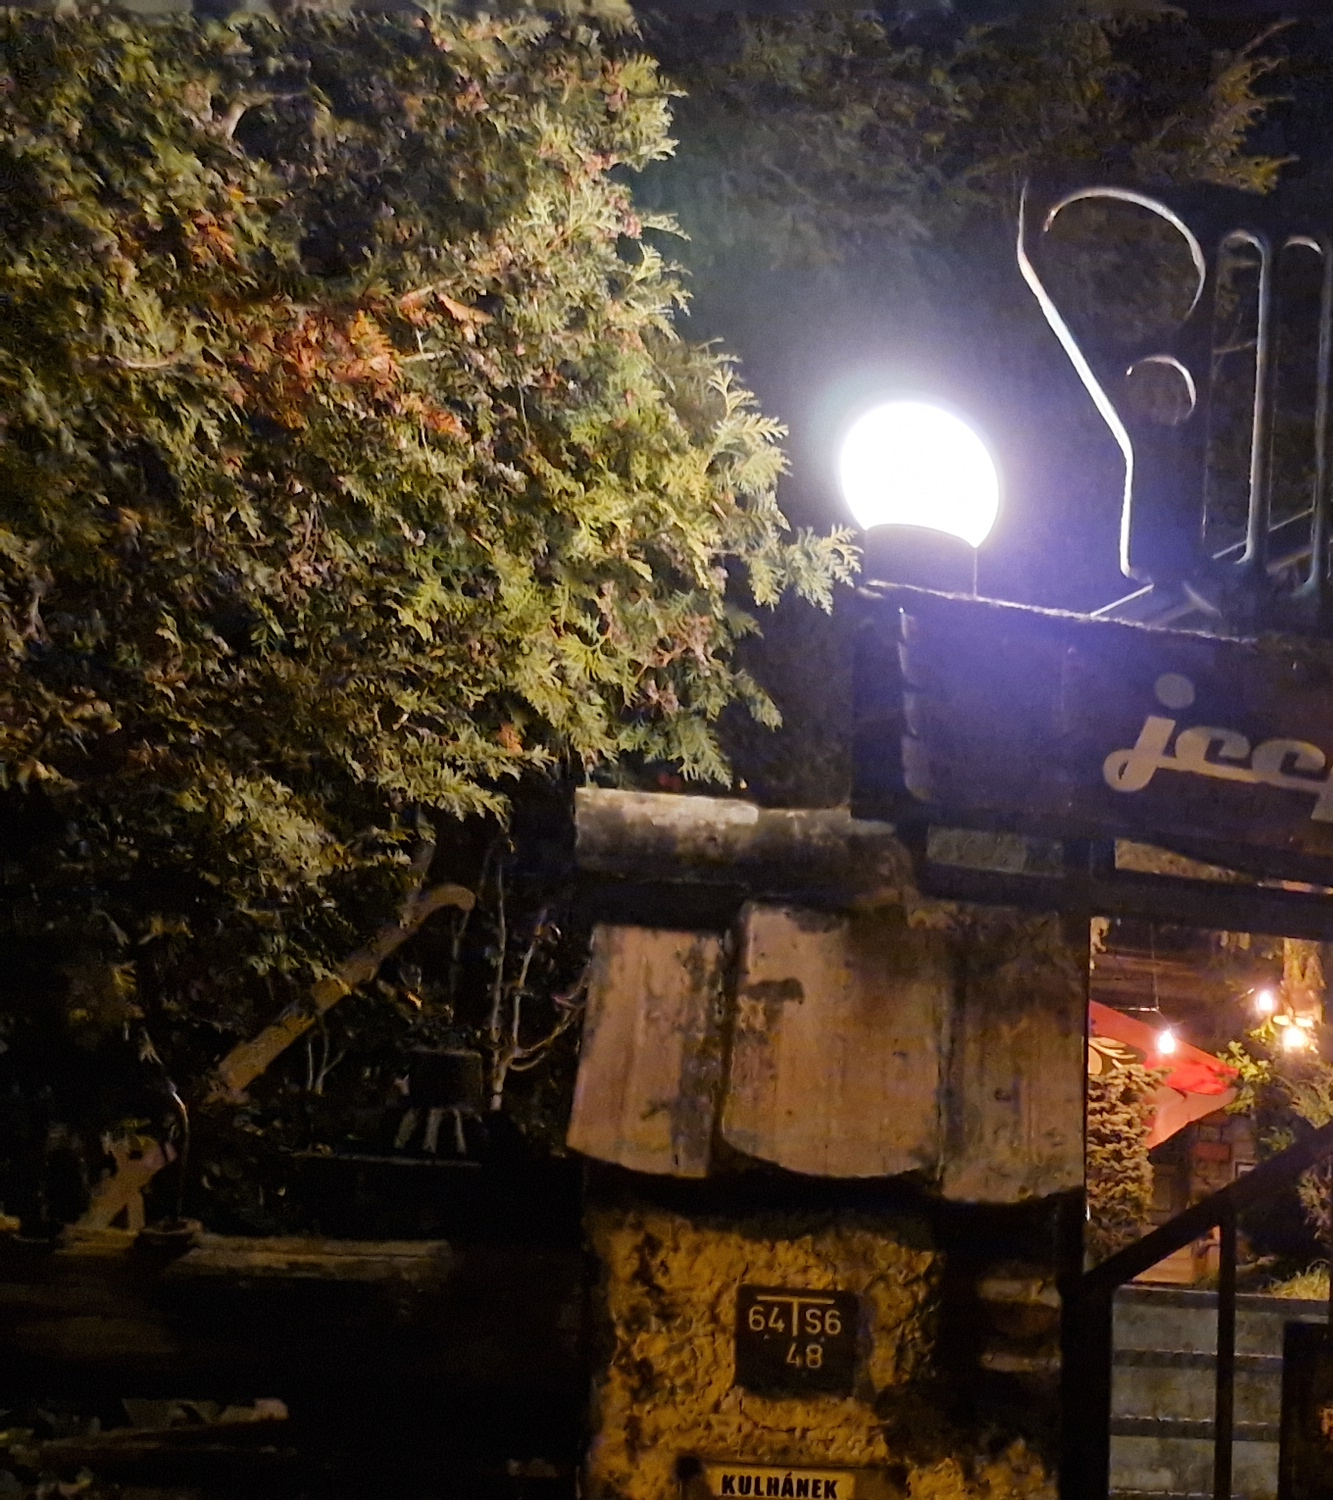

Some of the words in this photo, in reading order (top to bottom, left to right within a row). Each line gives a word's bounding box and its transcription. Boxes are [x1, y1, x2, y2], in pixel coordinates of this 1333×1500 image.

[748, 1305, 786, 1333] 64
[786, 1343, 824, 1369] 48
[721, 1472, 840, 1500] KULHÁNEK
